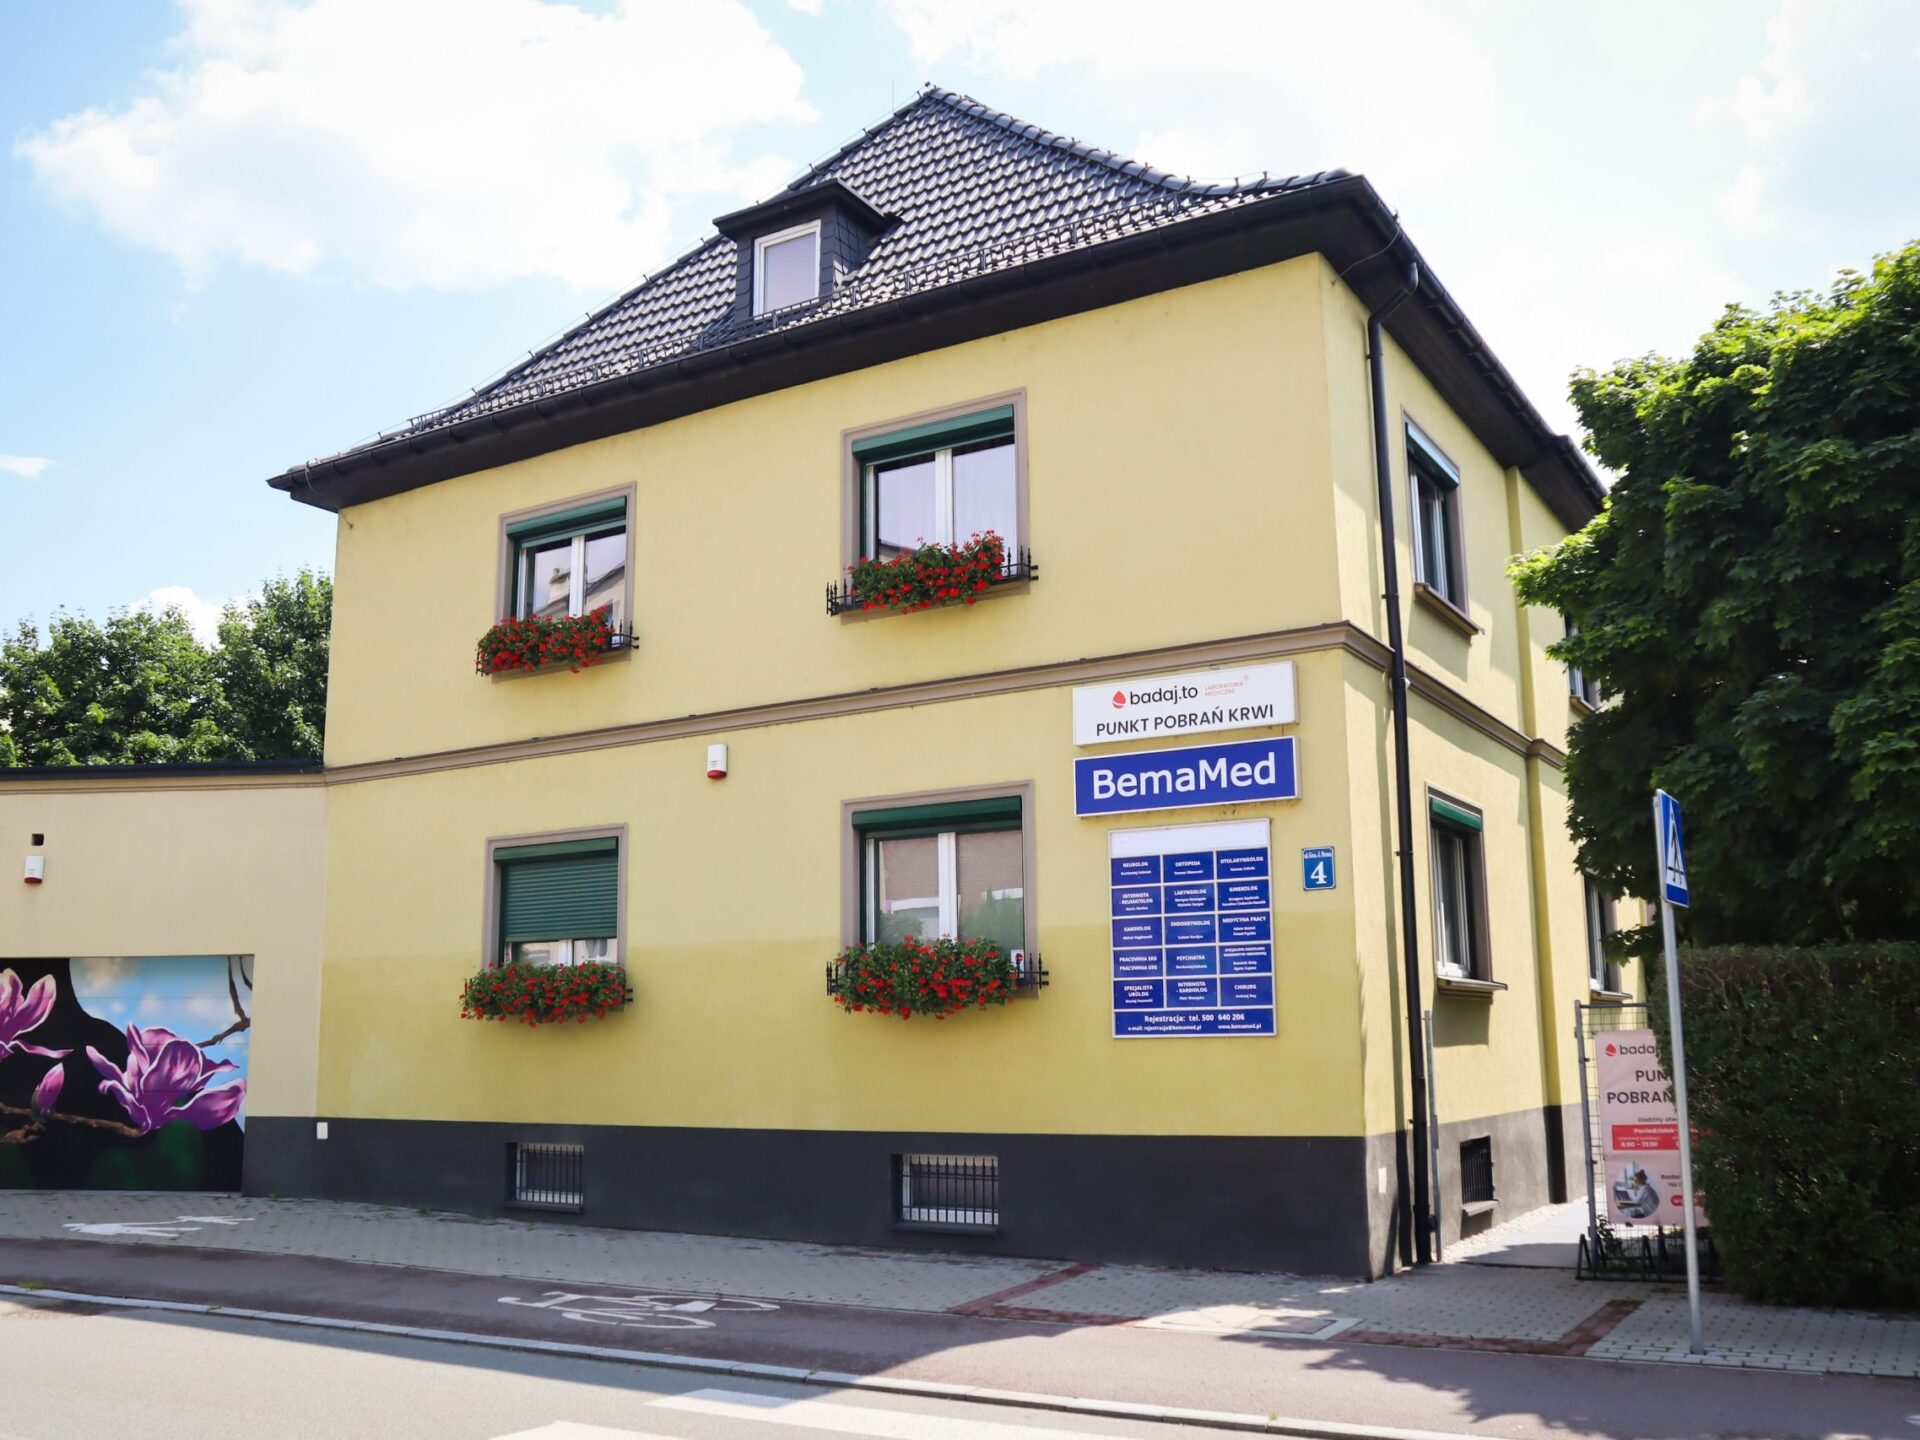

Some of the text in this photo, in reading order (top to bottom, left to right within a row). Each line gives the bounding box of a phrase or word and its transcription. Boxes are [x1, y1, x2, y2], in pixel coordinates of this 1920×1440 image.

[1130, 686, 1198, 705] badaj.to
[1096, 704, 1274, 736] PUNKT POBRAŃ KRWI
[1093, 752, 1276, 800] BemaMed
[1310, 861, 1328, 884] 4
[1144, 1015, 1186, 1024] Rejestracja:
[1217, 1013, 1231, 1021] 640
[1231, 1013, 1245, 1021] 206
